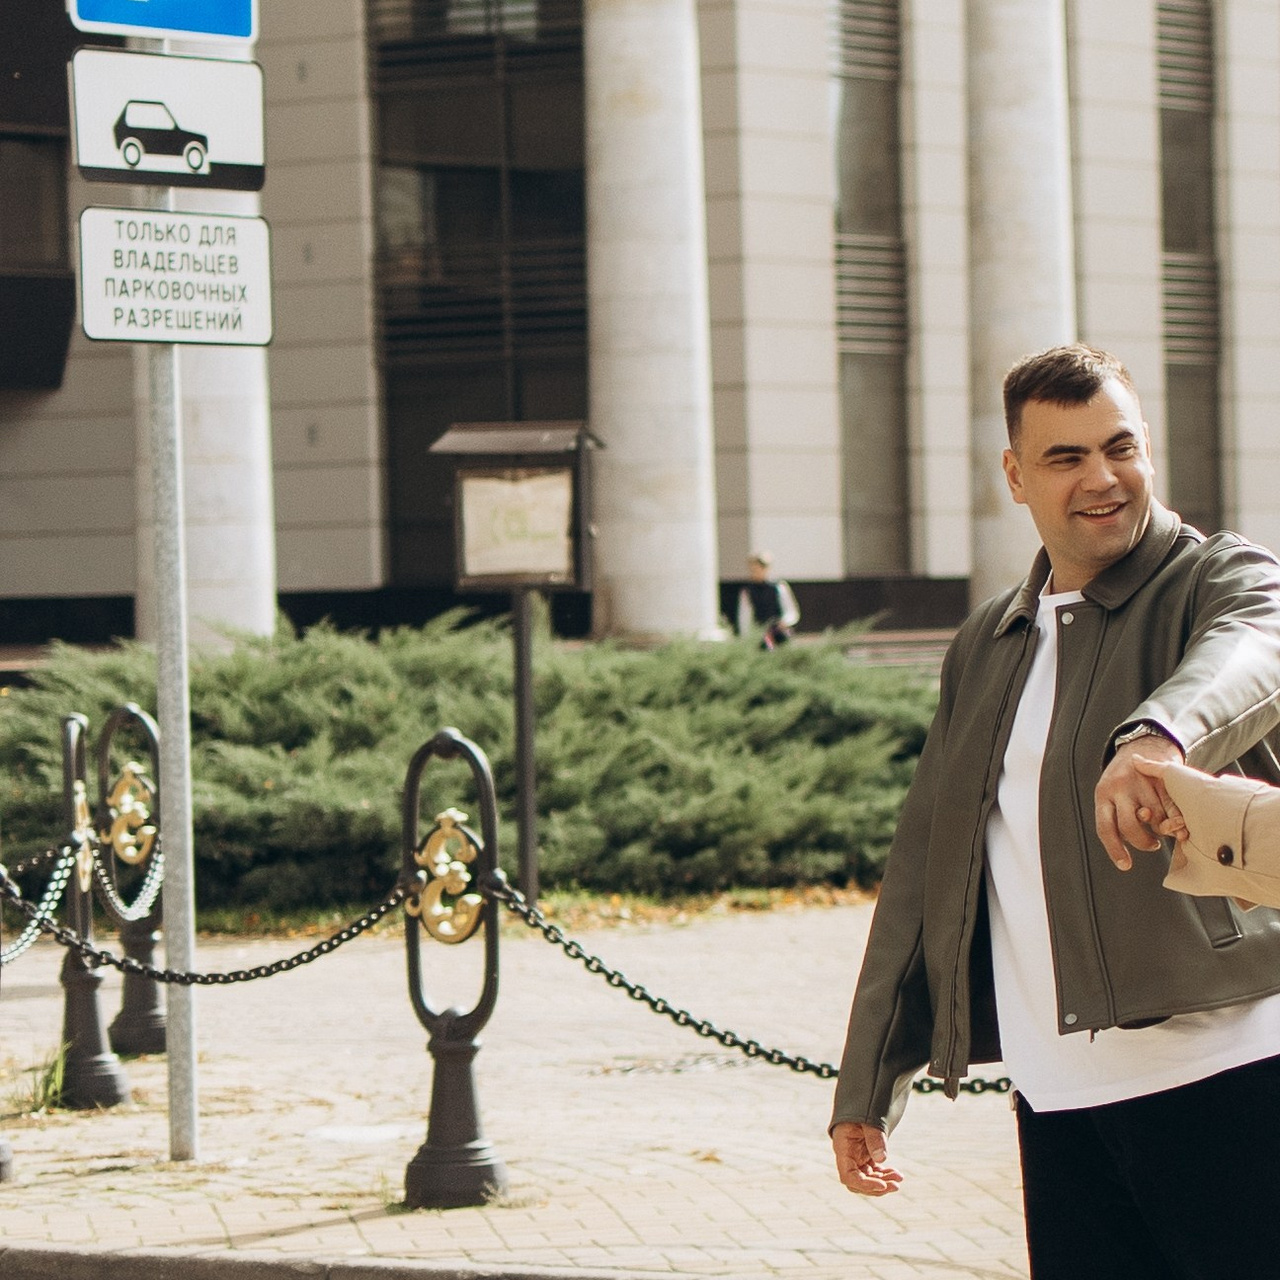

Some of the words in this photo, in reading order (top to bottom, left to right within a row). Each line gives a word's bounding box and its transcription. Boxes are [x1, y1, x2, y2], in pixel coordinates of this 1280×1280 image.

[114, 220, 190, 242] ТОЛЬКО
[199, 225, 236, 247] ДЛЯ
[113, 249, 239, 275] ВЛАДЕЛЬЦЕВ
[104, 278, 248, 303] ПАРКОВОЧНЫХ
[113, 307, 243, 332] РАЗРЕШЕНИЙ
